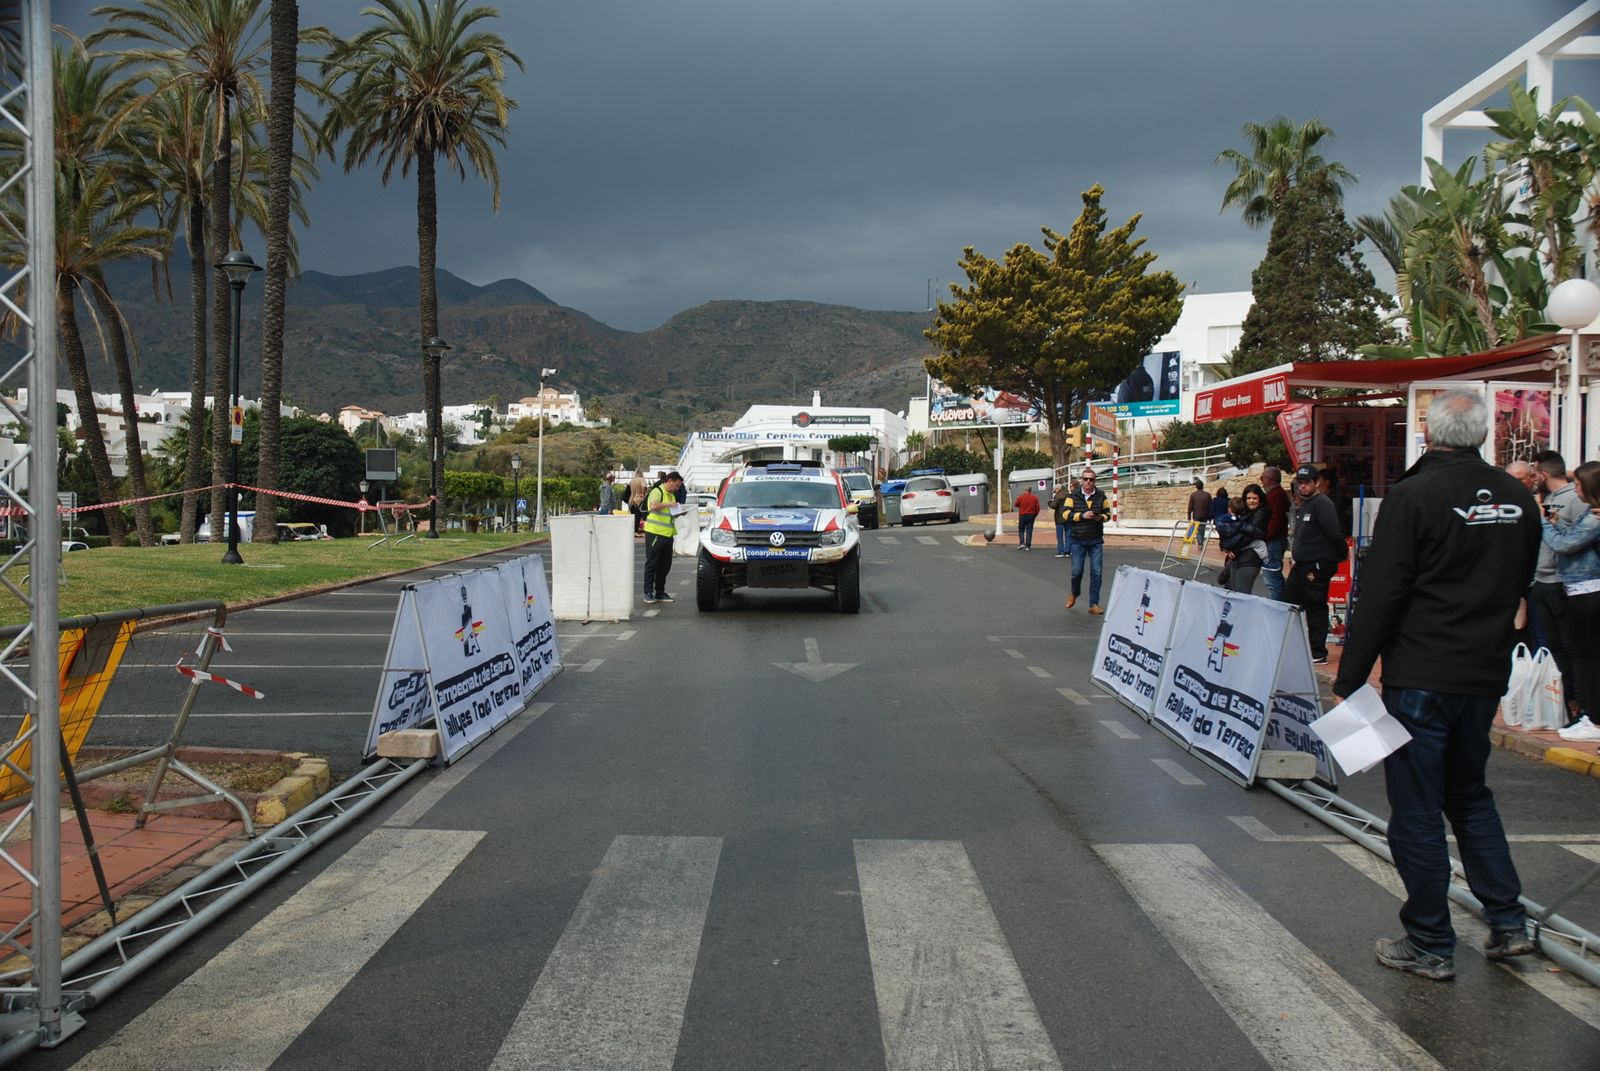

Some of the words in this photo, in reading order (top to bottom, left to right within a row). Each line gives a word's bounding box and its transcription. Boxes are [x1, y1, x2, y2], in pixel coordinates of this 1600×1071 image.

[1452, 504, 1523, 521] VSD
[746, 549, 809, 557] conarpesa.com.ar
[1211, 690, 1228, 708] de
[443, 709, 473, 738] allyes
